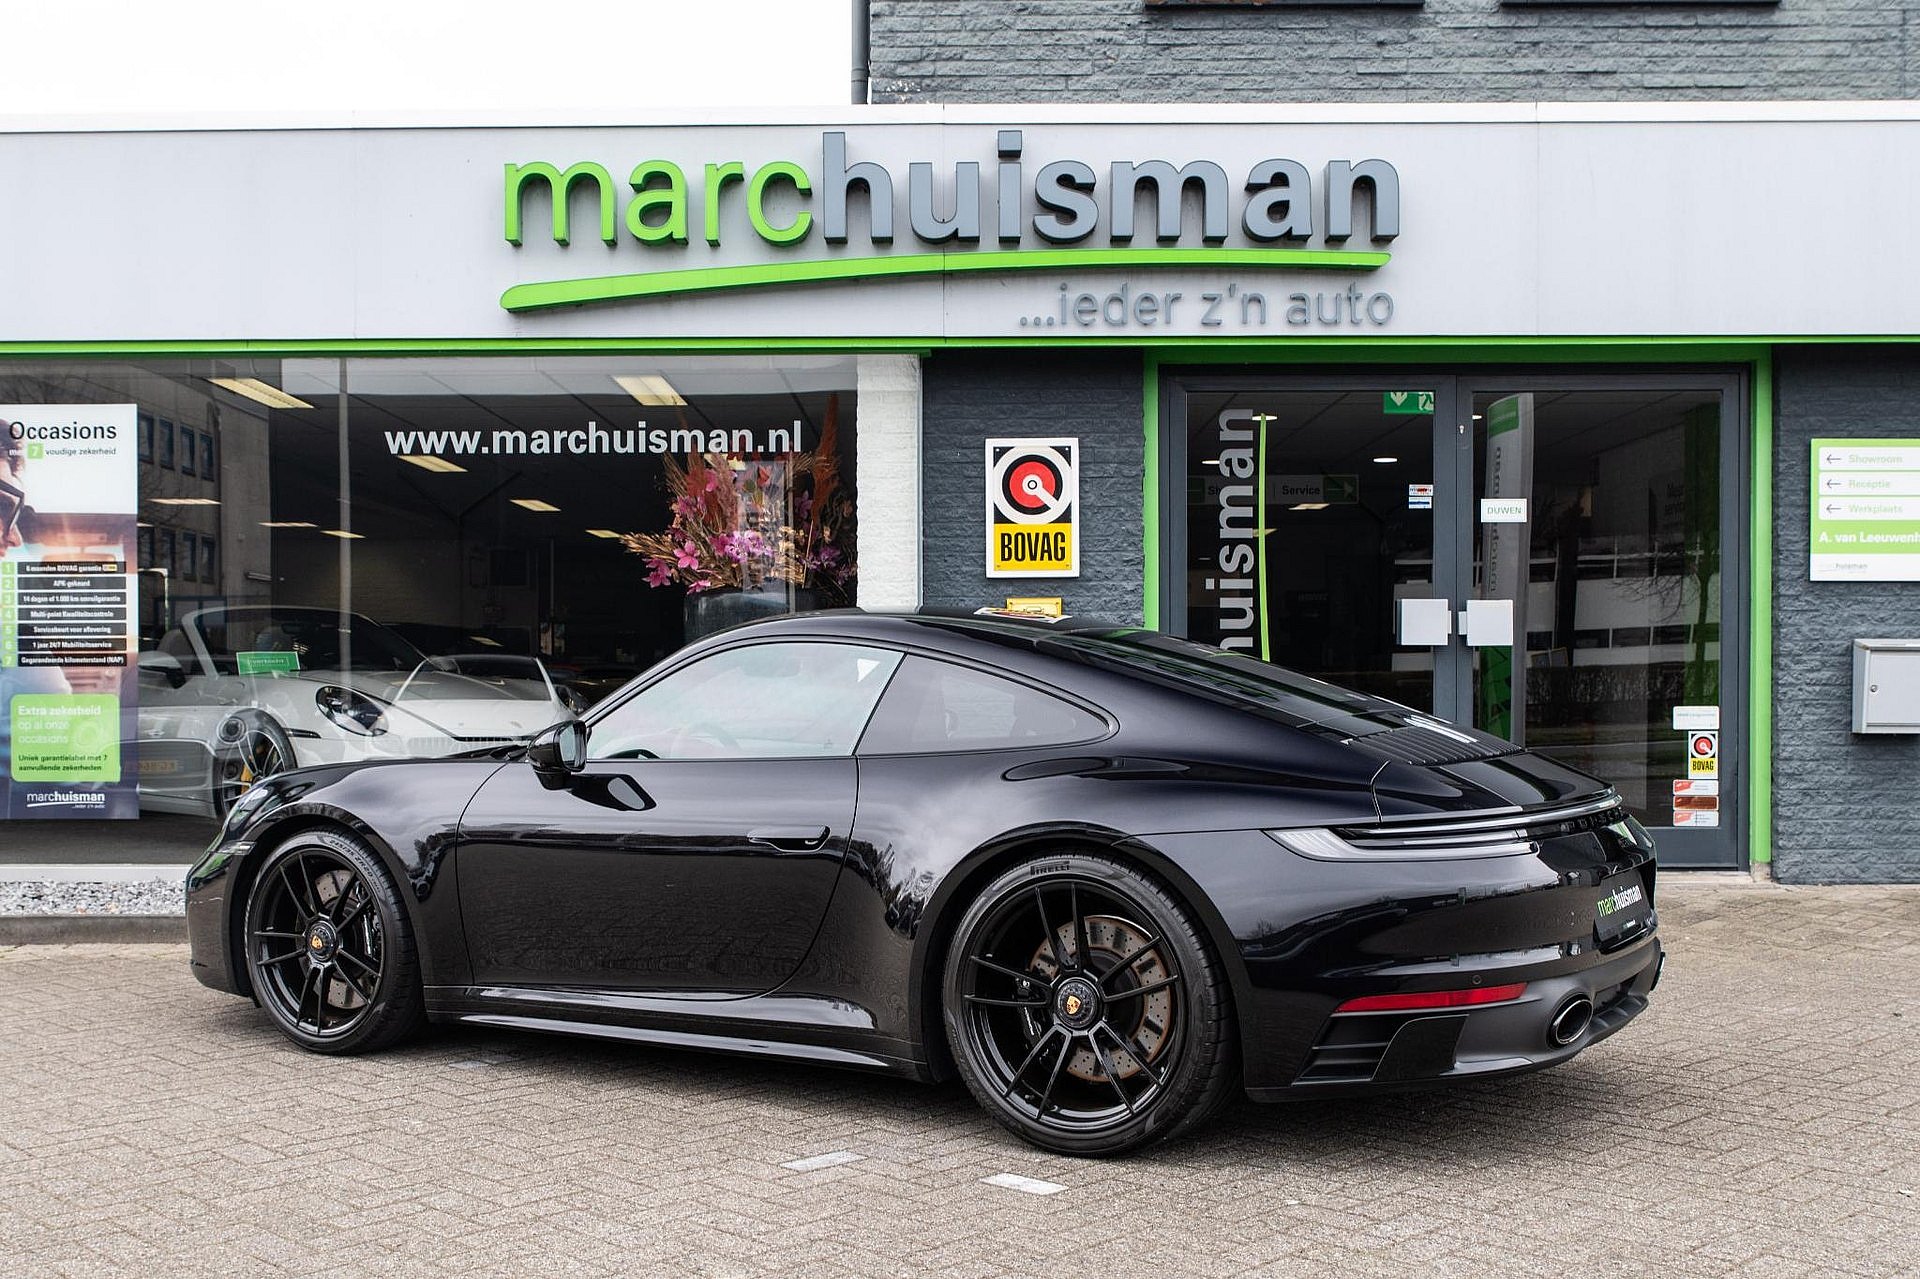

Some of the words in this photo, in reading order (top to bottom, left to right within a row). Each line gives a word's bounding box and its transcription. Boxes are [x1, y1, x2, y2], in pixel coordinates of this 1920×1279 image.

[504, 131, 1400, 247] marchuisman
[1019, 282, 1182, 327] ...ieder
[1201, 283, 1266, 326] z'n
[1286, 282, 1394, 327] auto
[9, 421, 117, 440] Occasions
[384, 419, 802, 454] www.marchuisman.nl
[30, 446, 39, 457] 7
[46, 447, 76, 457] voudige
[79, 447, 116, 456] zekerheid
[1848, 454, 1903, 464] Showroom
[1282, 485, 1320, 496] Service
[1848, 480, 1890, 490] Receptie
[1487, 506, 1522, 515] DUWEN
[1848, 504, 1903, 514] Werkplaats
[1818, 533, 1832, 543] A.
[1835, 534, 1856, 543] van
[1000, 531, 1066, 562] BOVAG
[18, 706, 47, 715] Extra
[49, 705, 101, 715] zekerheid
[1692, 761, 1714, 771] BOVAG
[27, 791, 105, 802] marchuisman
[1597, 884, 1642, 918] marchuisman
